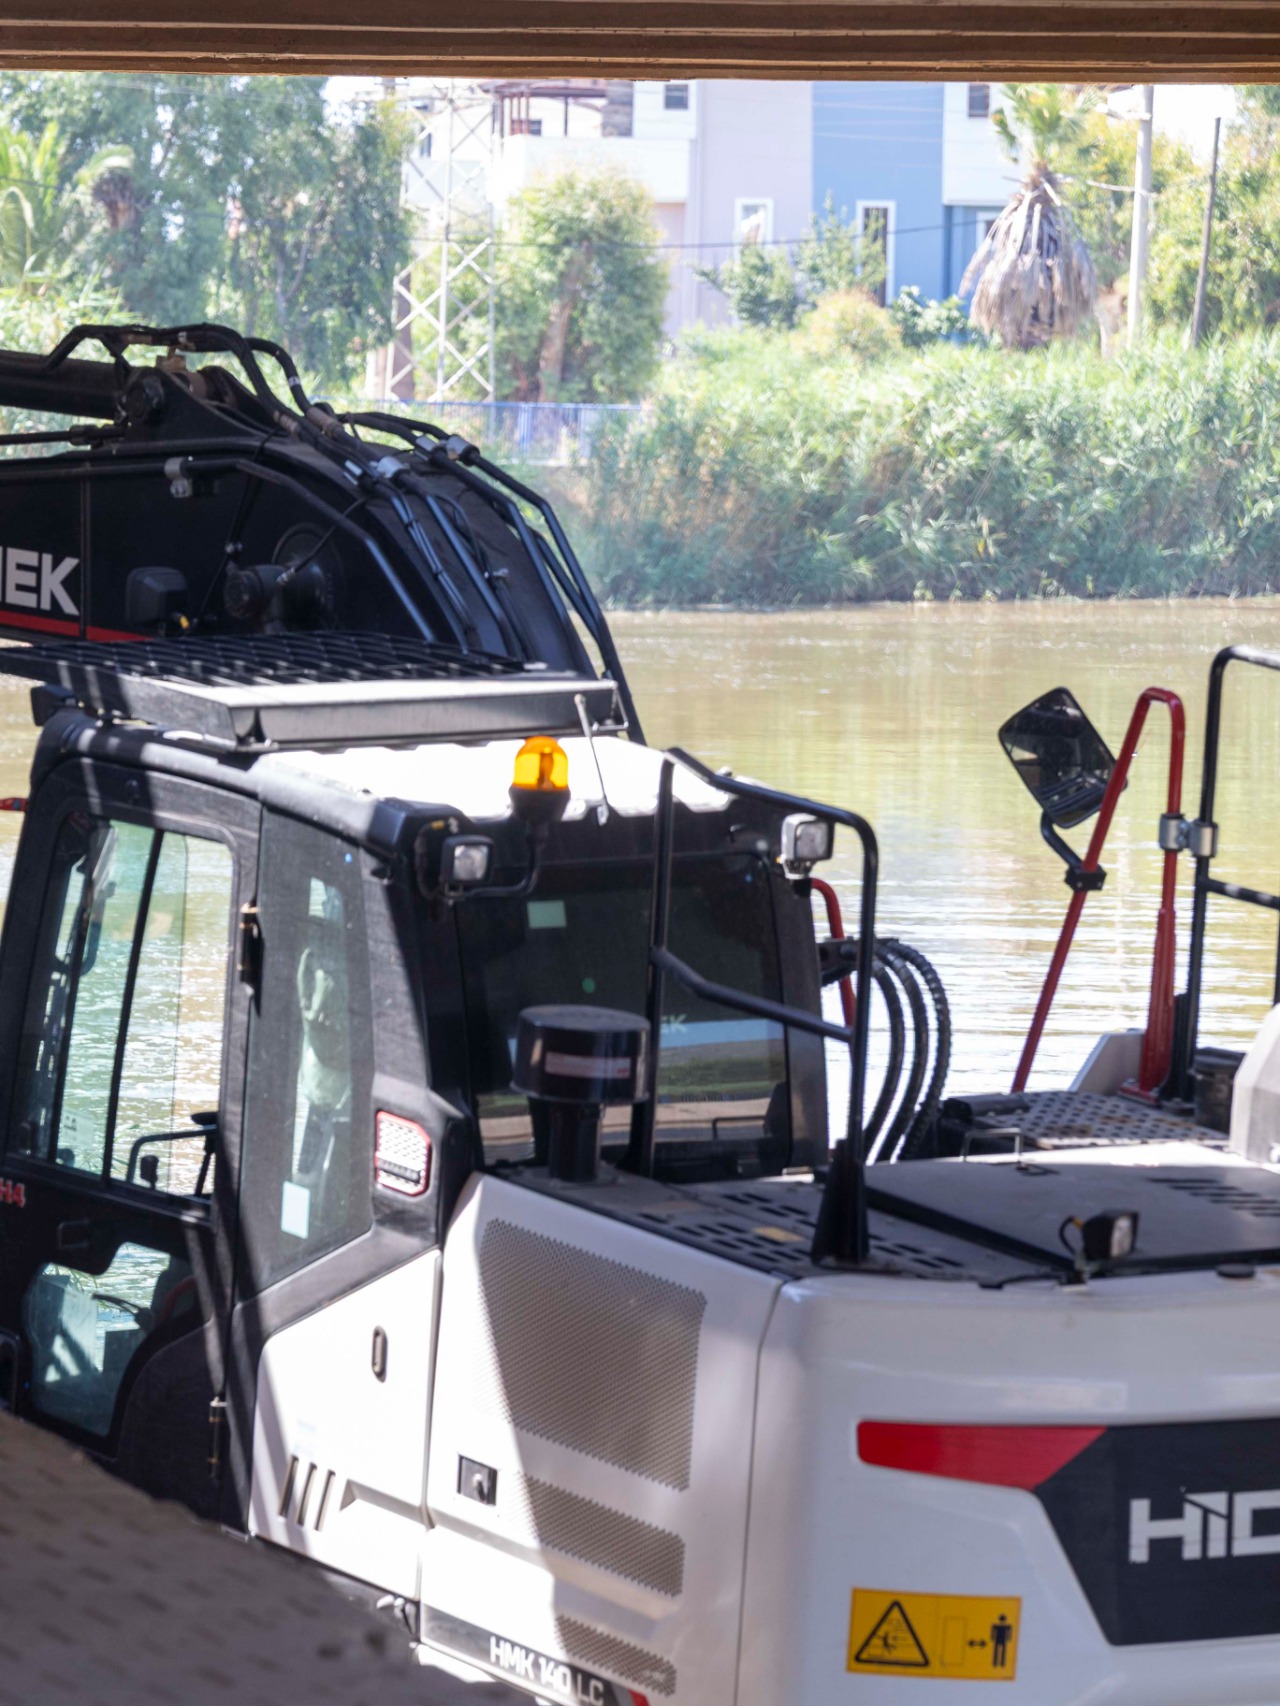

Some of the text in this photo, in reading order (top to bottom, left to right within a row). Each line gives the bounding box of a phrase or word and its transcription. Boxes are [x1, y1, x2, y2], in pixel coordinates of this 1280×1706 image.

[489, 1636, 605, 1706] HMK 140 LC
